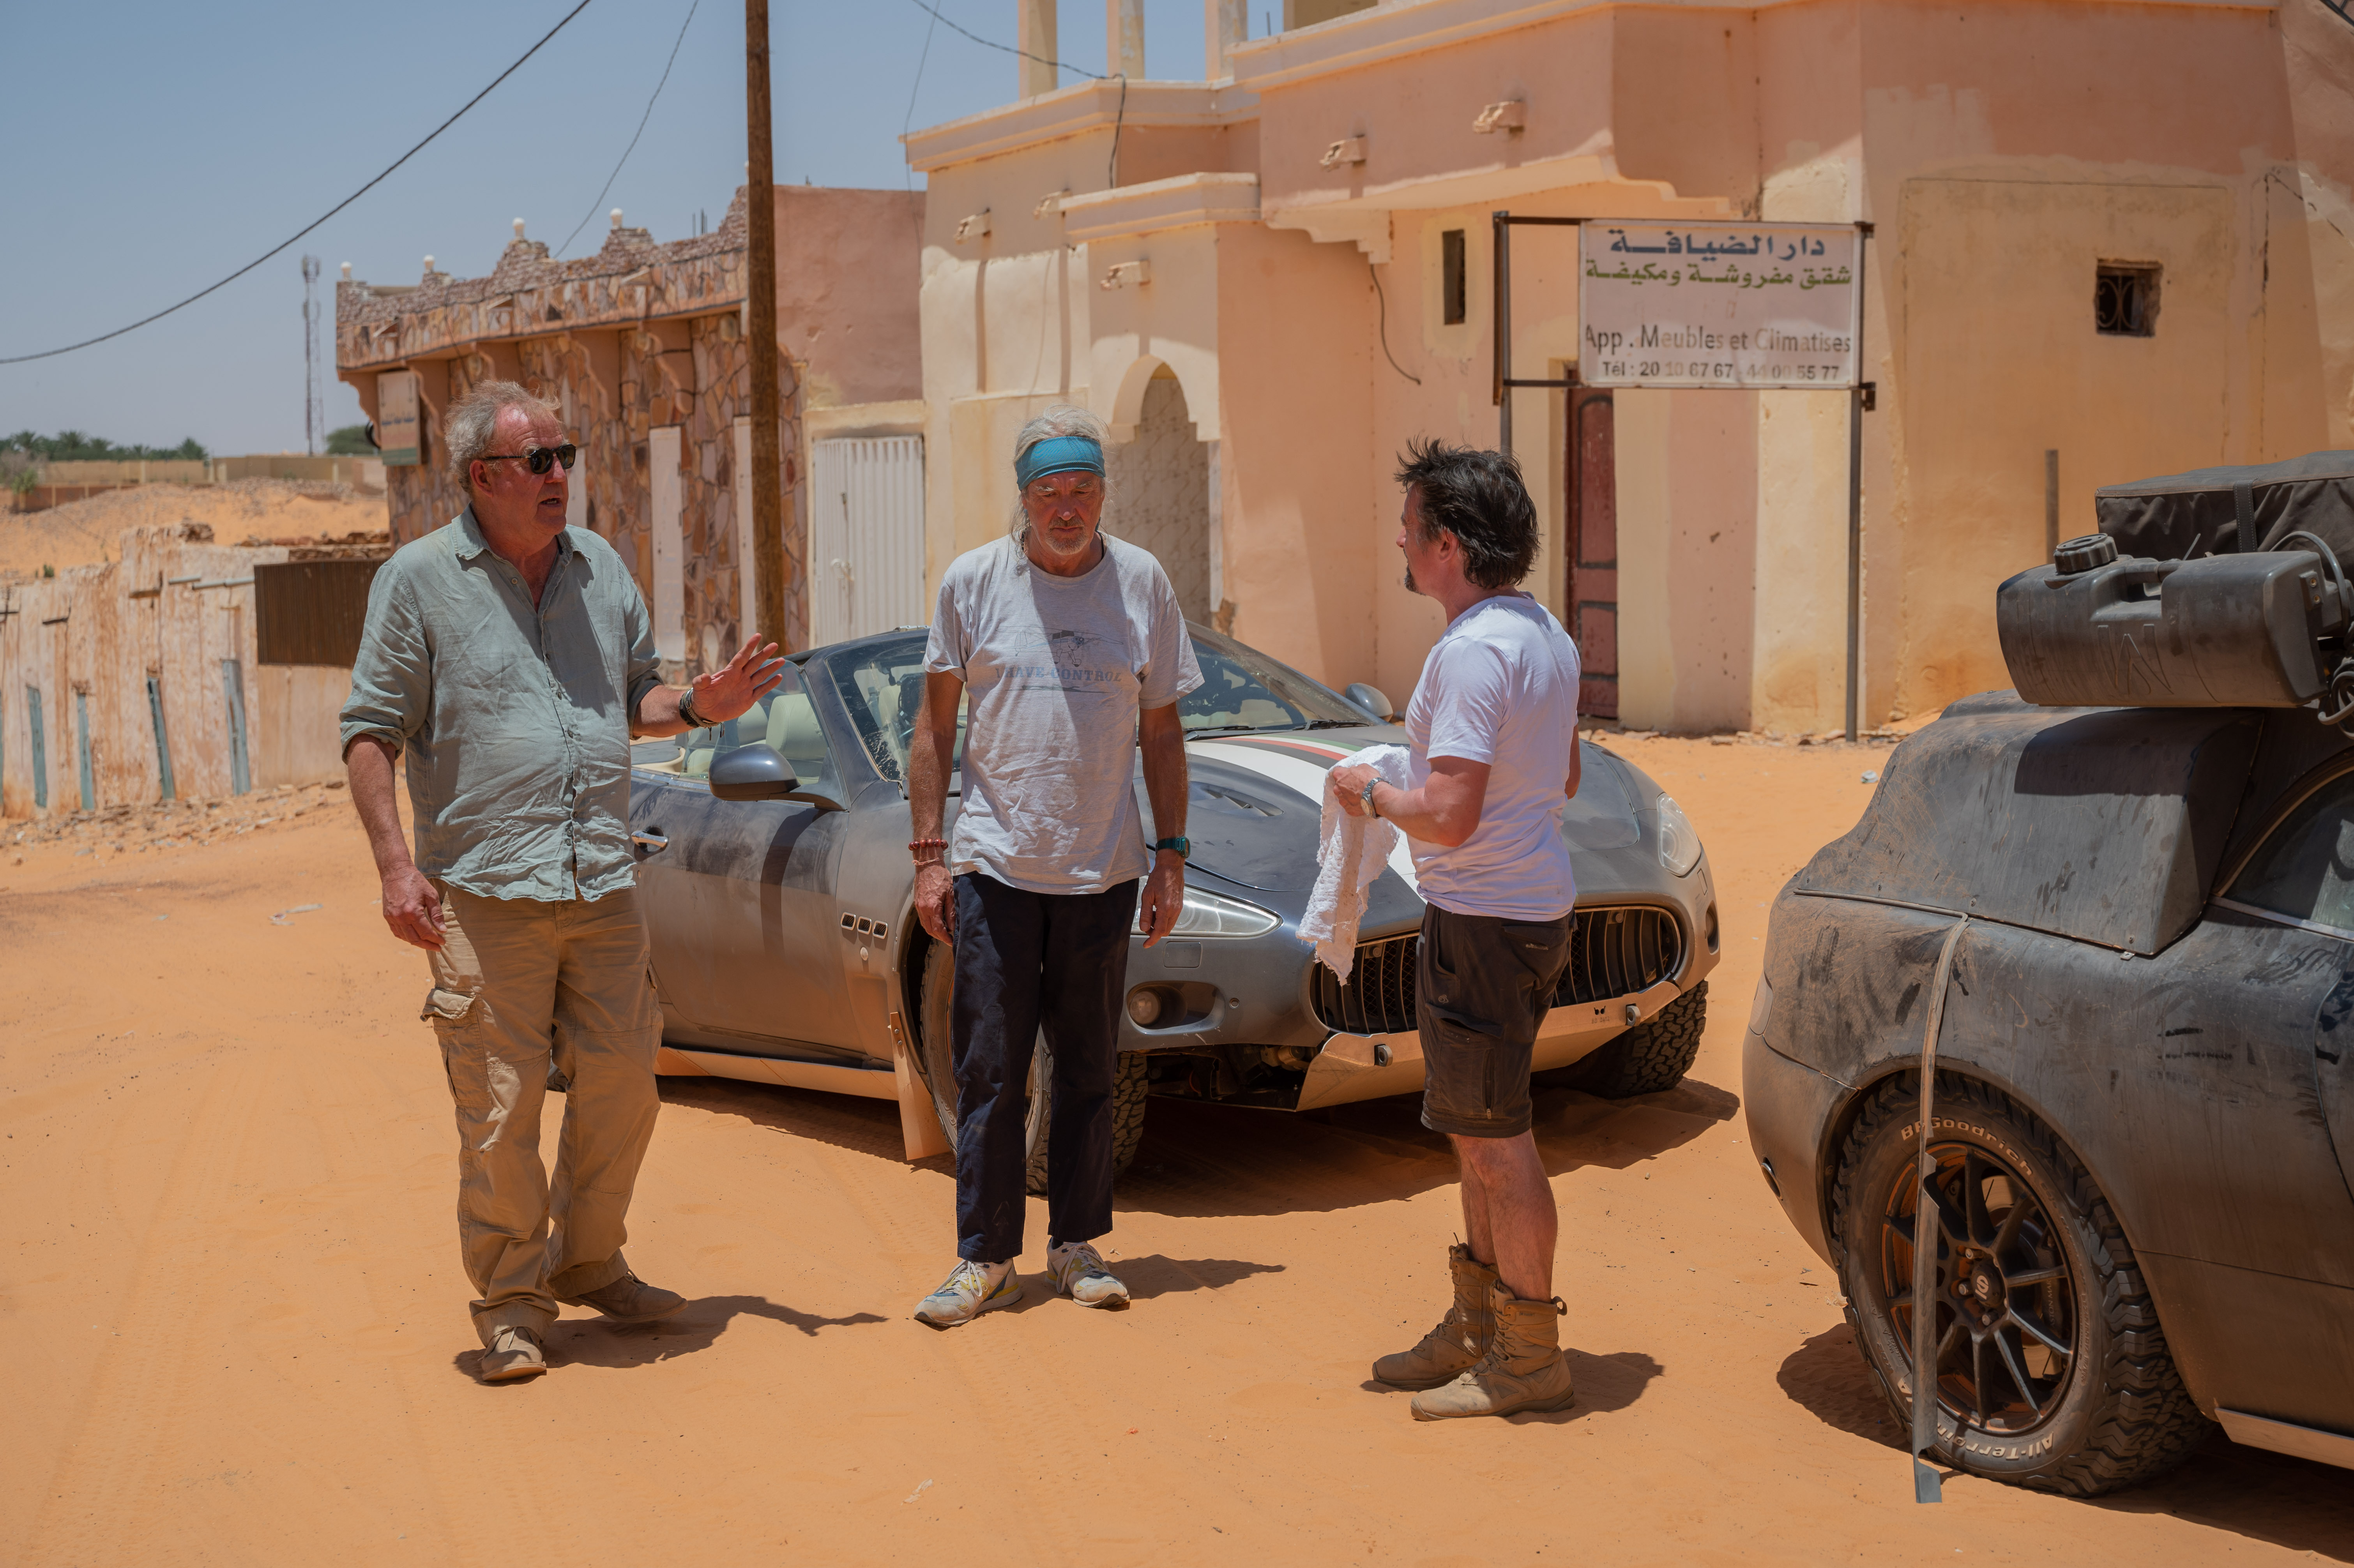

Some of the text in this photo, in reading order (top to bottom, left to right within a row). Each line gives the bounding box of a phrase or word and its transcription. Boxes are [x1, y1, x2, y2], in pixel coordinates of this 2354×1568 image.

[1778, 236, 1825, 260] دار
[1586, 259, 1851, 290] شقق مفروشة ومكيفة
[1640, 324, 1723, 349] Meubles
[1729, 332, 1748, 350] et
[1755, 328, 1850, 352] Climatises
[1640, 361, 1660, 376] 20
[1665, 361, 1684, 377] 10
[1689, 362, 1709, 377] 67
[1714, 363, 1733, 378] 67
[1797, 365, 1816, 380] 55
[1821, 365, 1840, 380] 77
[1004, 667, 1044, 678] HAVE
[1051, 667, 1122, 682] CONTROL
[931, 1034, 957, 1136] odrich
